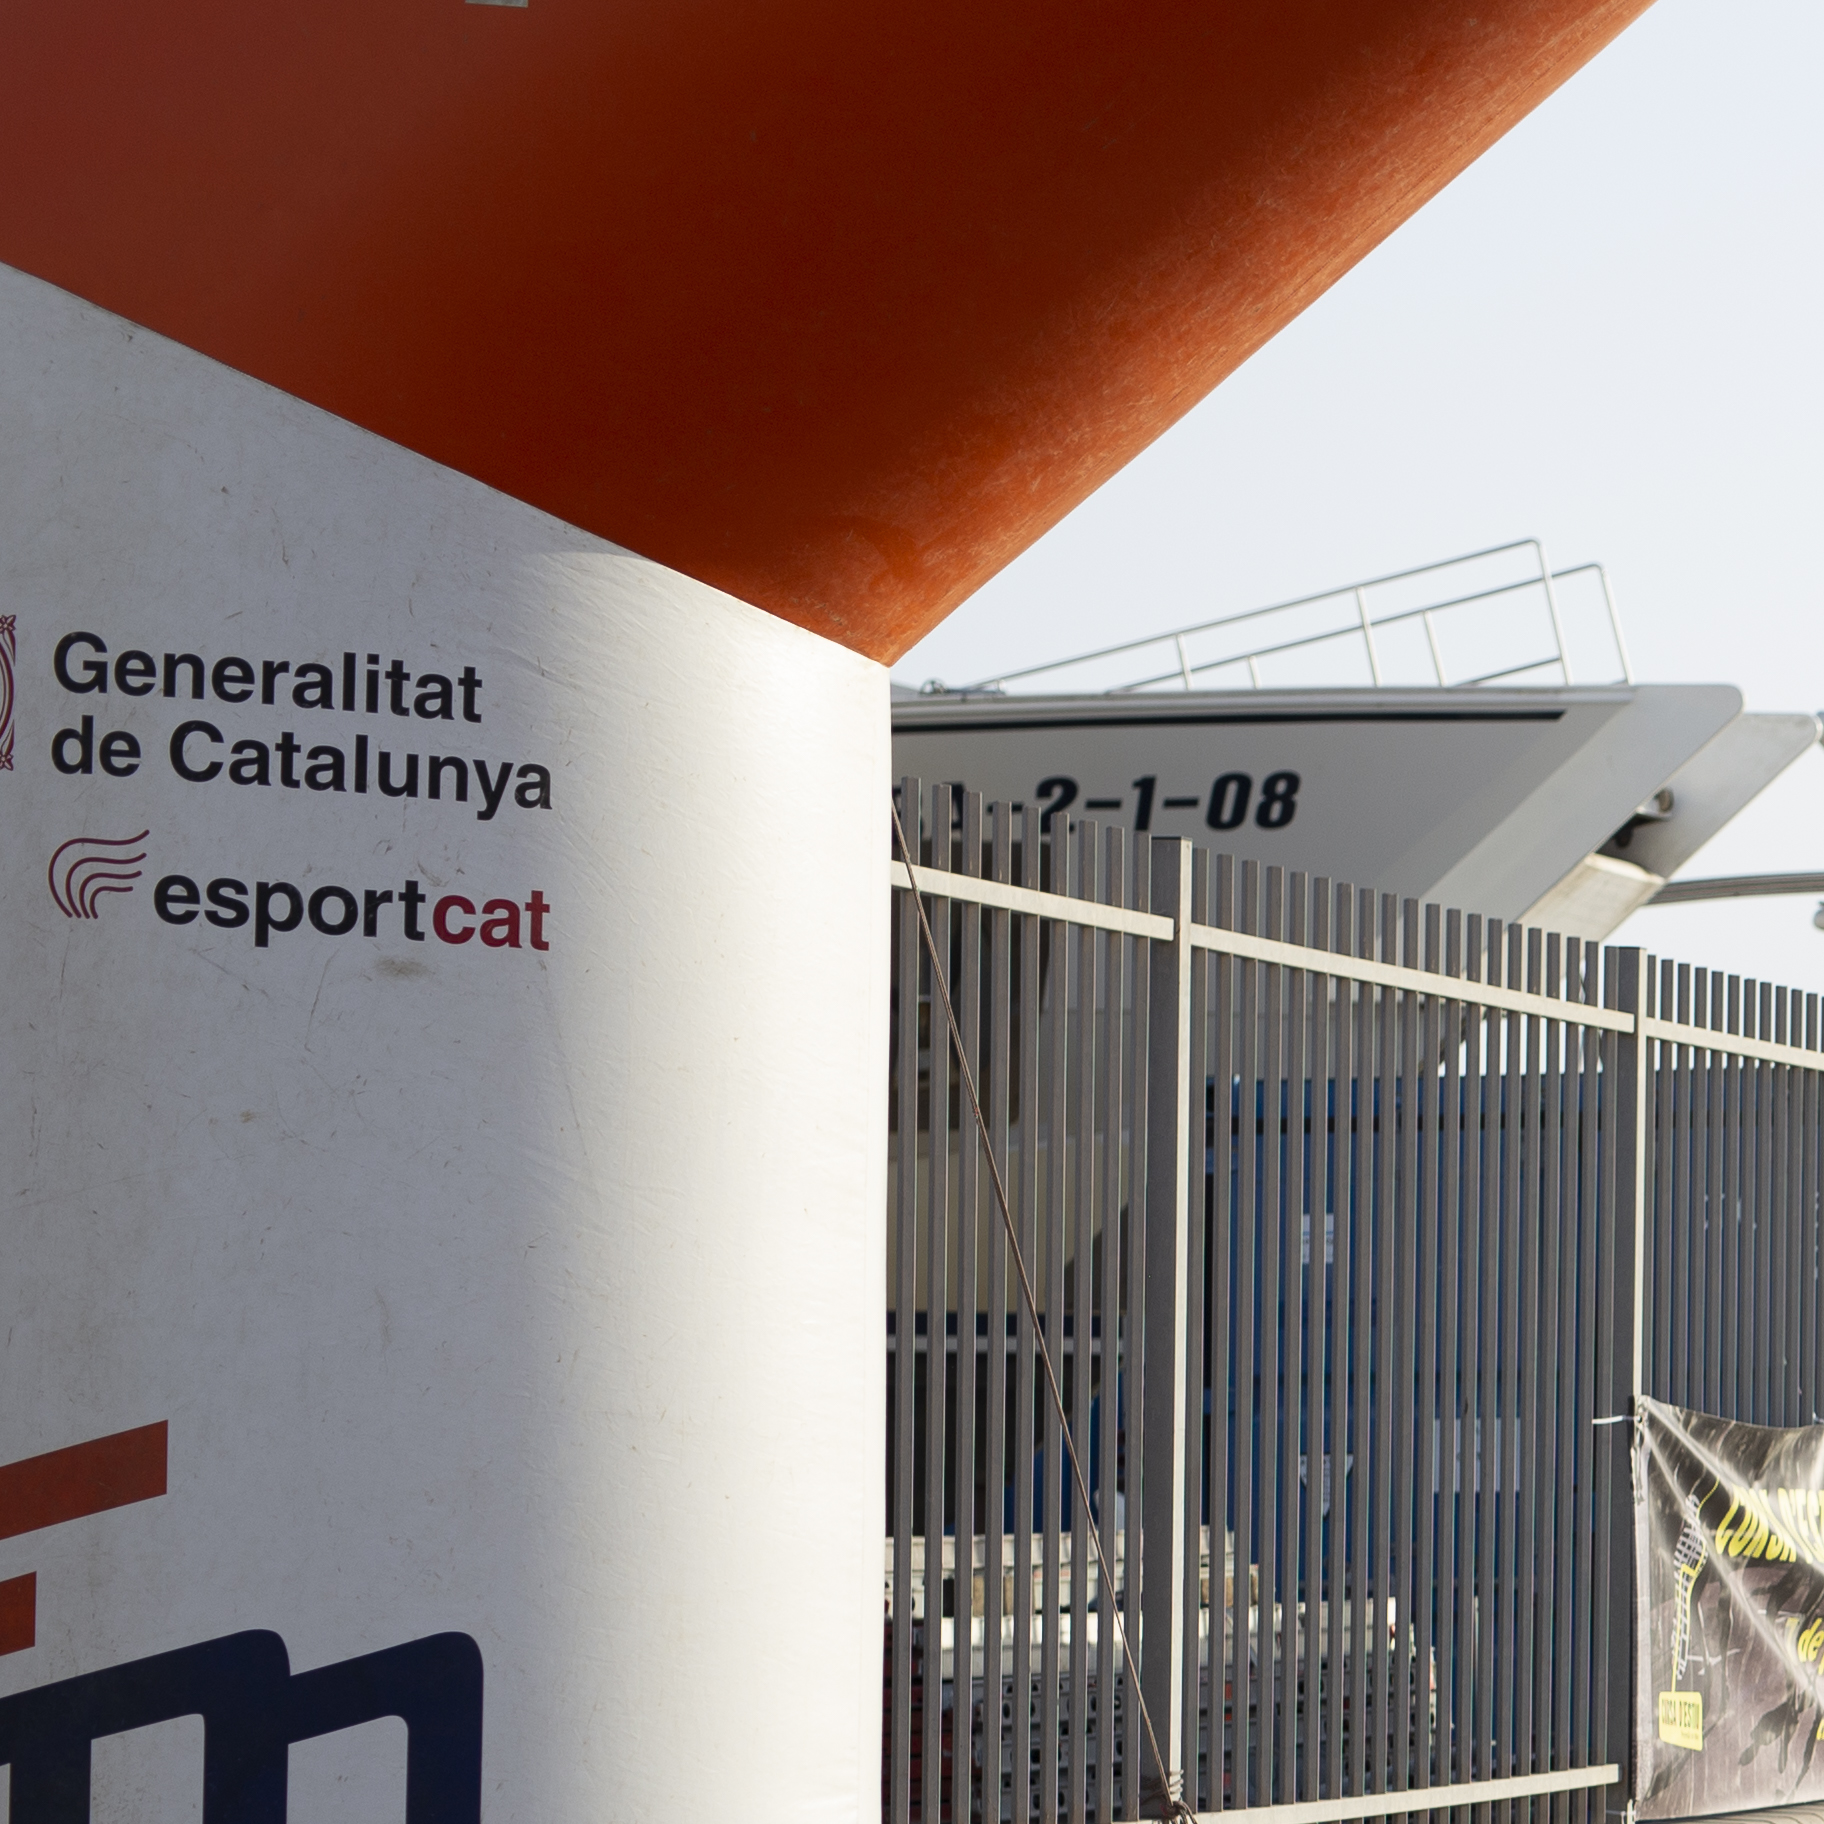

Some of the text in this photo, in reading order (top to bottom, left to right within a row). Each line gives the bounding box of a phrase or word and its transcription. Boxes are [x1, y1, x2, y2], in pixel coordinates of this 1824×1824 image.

[53, 631, 483, 724] Generalitat
[51, 714, 553, 821] de Catalunya
[153, 874, 551, 951] esportcat
